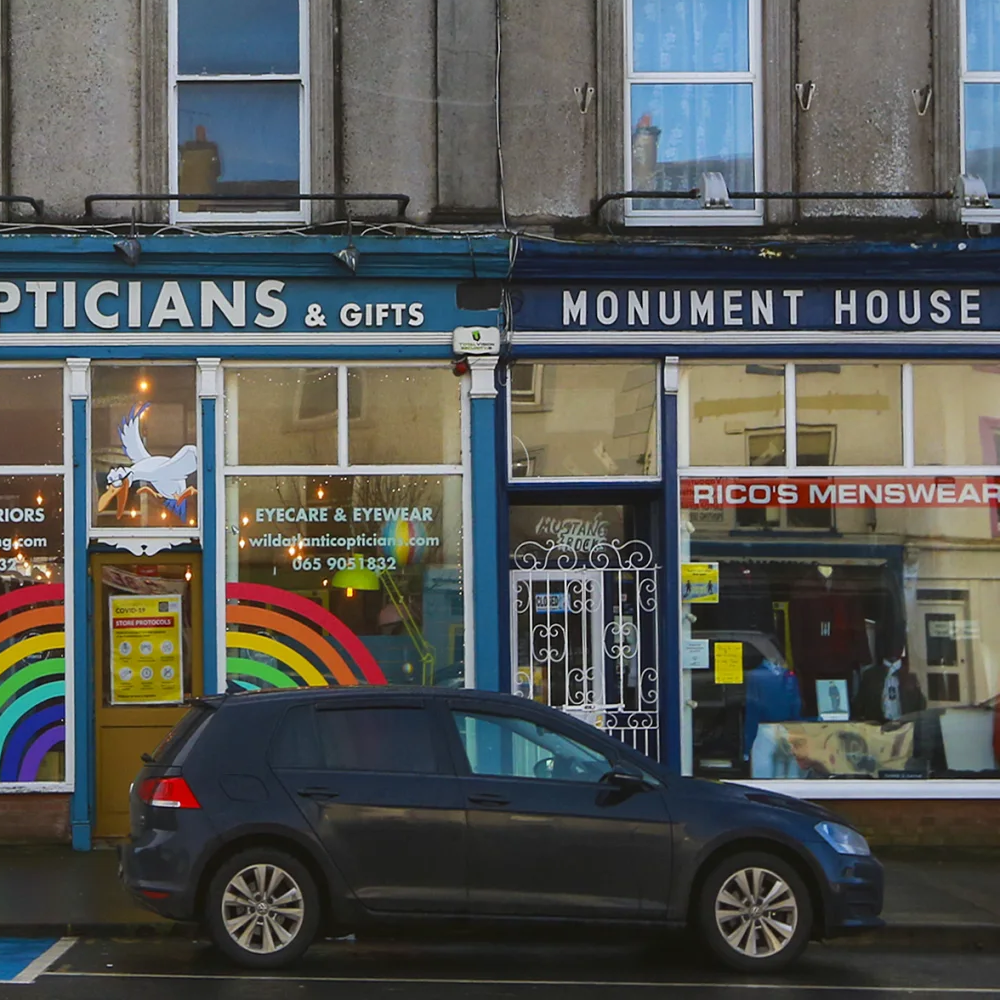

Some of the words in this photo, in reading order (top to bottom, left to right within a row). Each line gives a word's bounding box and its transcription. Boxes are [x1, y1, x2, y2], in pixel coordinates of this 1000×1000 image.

[304, 303, 327, 328] &
[339, 302, 425, 328] GIFTS
[562, 289, 804, 326] MONUMENT
[834, 289, 981, 326] HOUSE
[693, 483, 799, 505] RICO'S
[808, 482, 1000, 505] MENSWEAR
[255, 507, 329, 523] EYECARE
[333, 507, 348, 523] &
[353, 507, 433, 522] EYEWEAR
[249, 533, 440, 551] wildatlanticopticians.com
[292, 557, 322, 571] 065
[326, 557, 397, 571] 9051832
